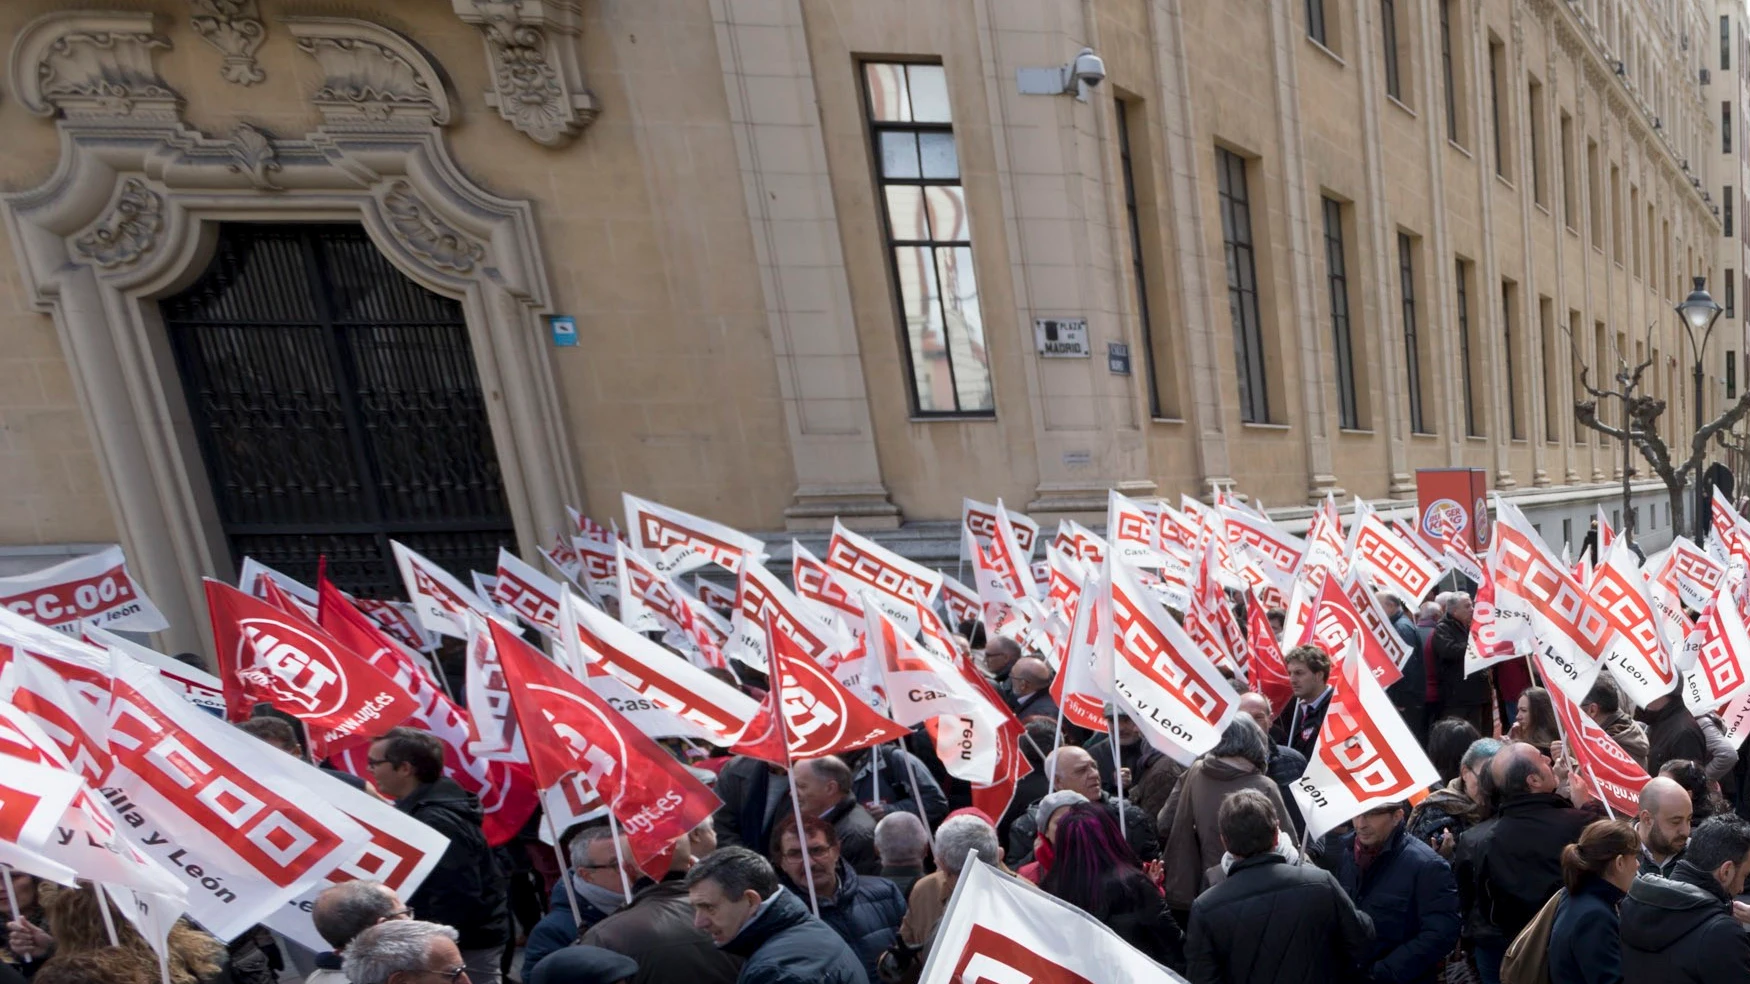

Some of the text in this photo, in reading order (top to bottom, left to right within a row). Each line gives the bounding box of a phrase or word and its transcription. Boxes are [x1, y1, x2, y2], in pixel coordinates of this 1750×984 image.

[1045, 343, 1082, 353] MADRID
[969, 515, 1032, 547] CCO
[1429, 508, 1461, 523] BUGER
[831, 543, 926, 600] CCOO
[1360, 533, 1424, 592] CCOO
[1496, 537, 1607, 646] CCOO
[1589, 576, 1669, 676] CCOO
[1545, 645, 1579, 681] León
[1608, 651, 1619, 661] y
[1151, 707, 1193, 742] León
[109, 697, 319, 869] CCOO
[141, 830, 169, 847] y
[168, 848, 238, 905] León
